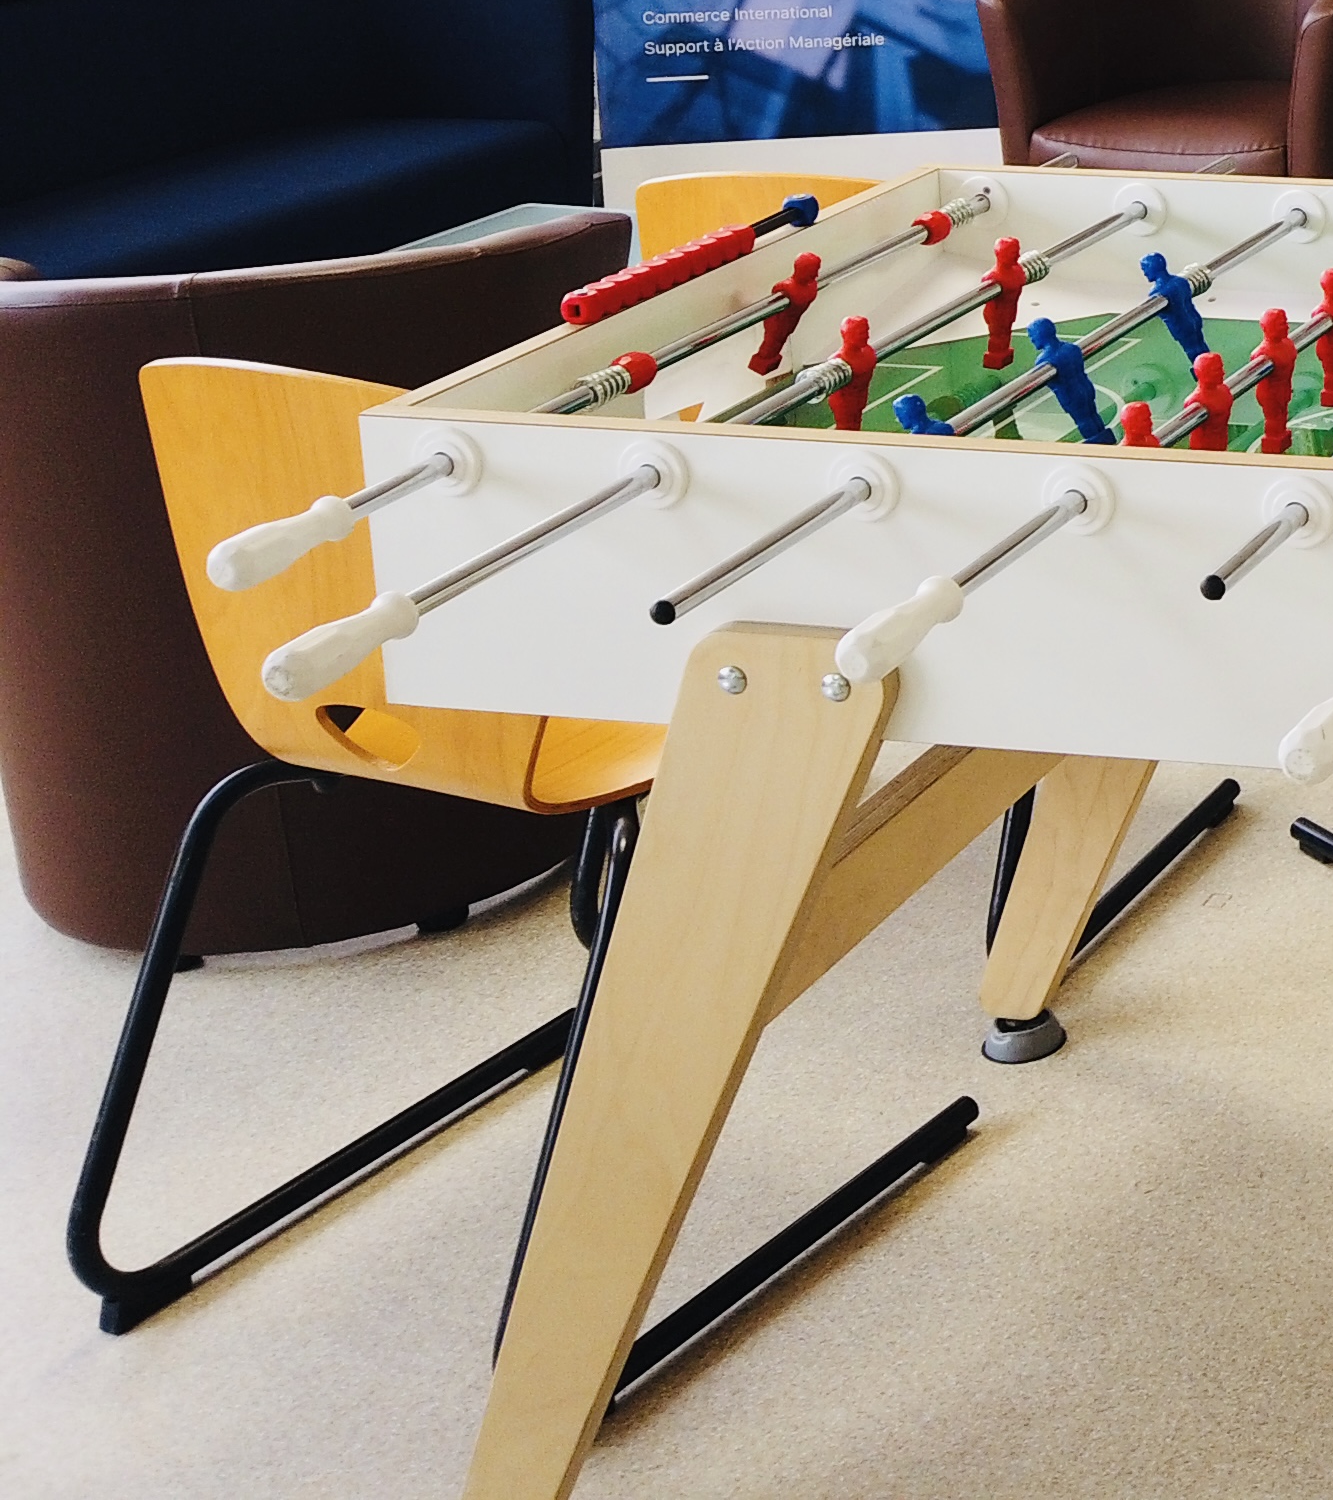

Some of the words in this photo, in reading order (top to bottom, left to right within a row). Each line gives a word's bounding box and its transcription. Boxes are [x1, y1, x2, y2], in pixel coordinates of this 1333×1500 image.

[643, 9, 729, 25] Commerce
[735, 5, 832, 21] International
[644, 40, 709, 56] Support
[714, 38, 723, 52] à
[728, 38, 784, 51] l'Action
[789, 33, 884, 51] Managériale
